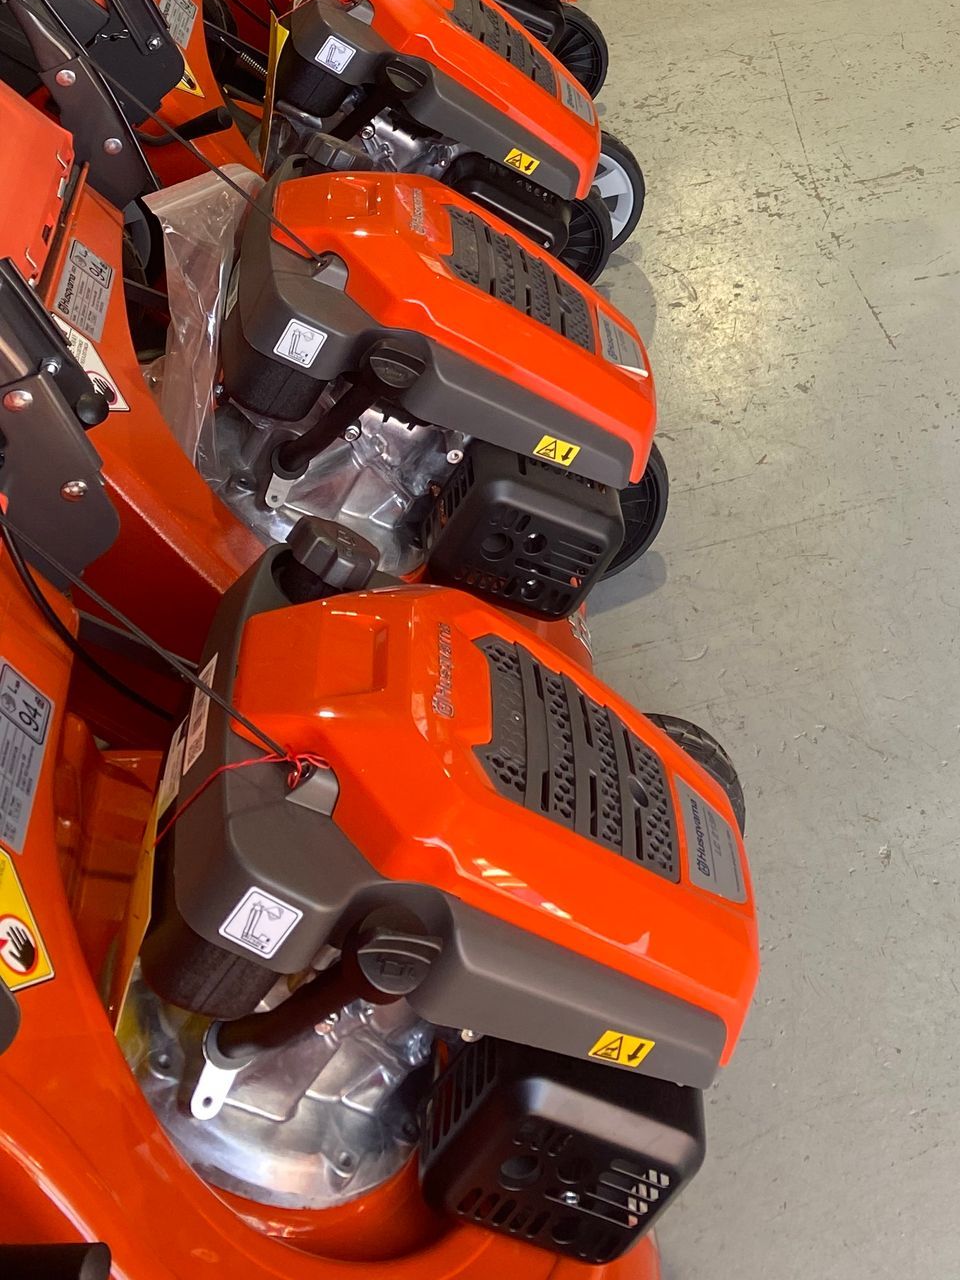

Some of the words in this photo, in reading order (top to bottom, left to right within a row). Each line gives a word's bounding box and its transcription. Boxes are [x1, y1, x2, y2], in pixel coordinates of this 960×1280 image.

[61, 274, 76, 309] Husqvarna
[19, 700, 42, 732] 94
[690, 798, 706, 861] Husqvarna
